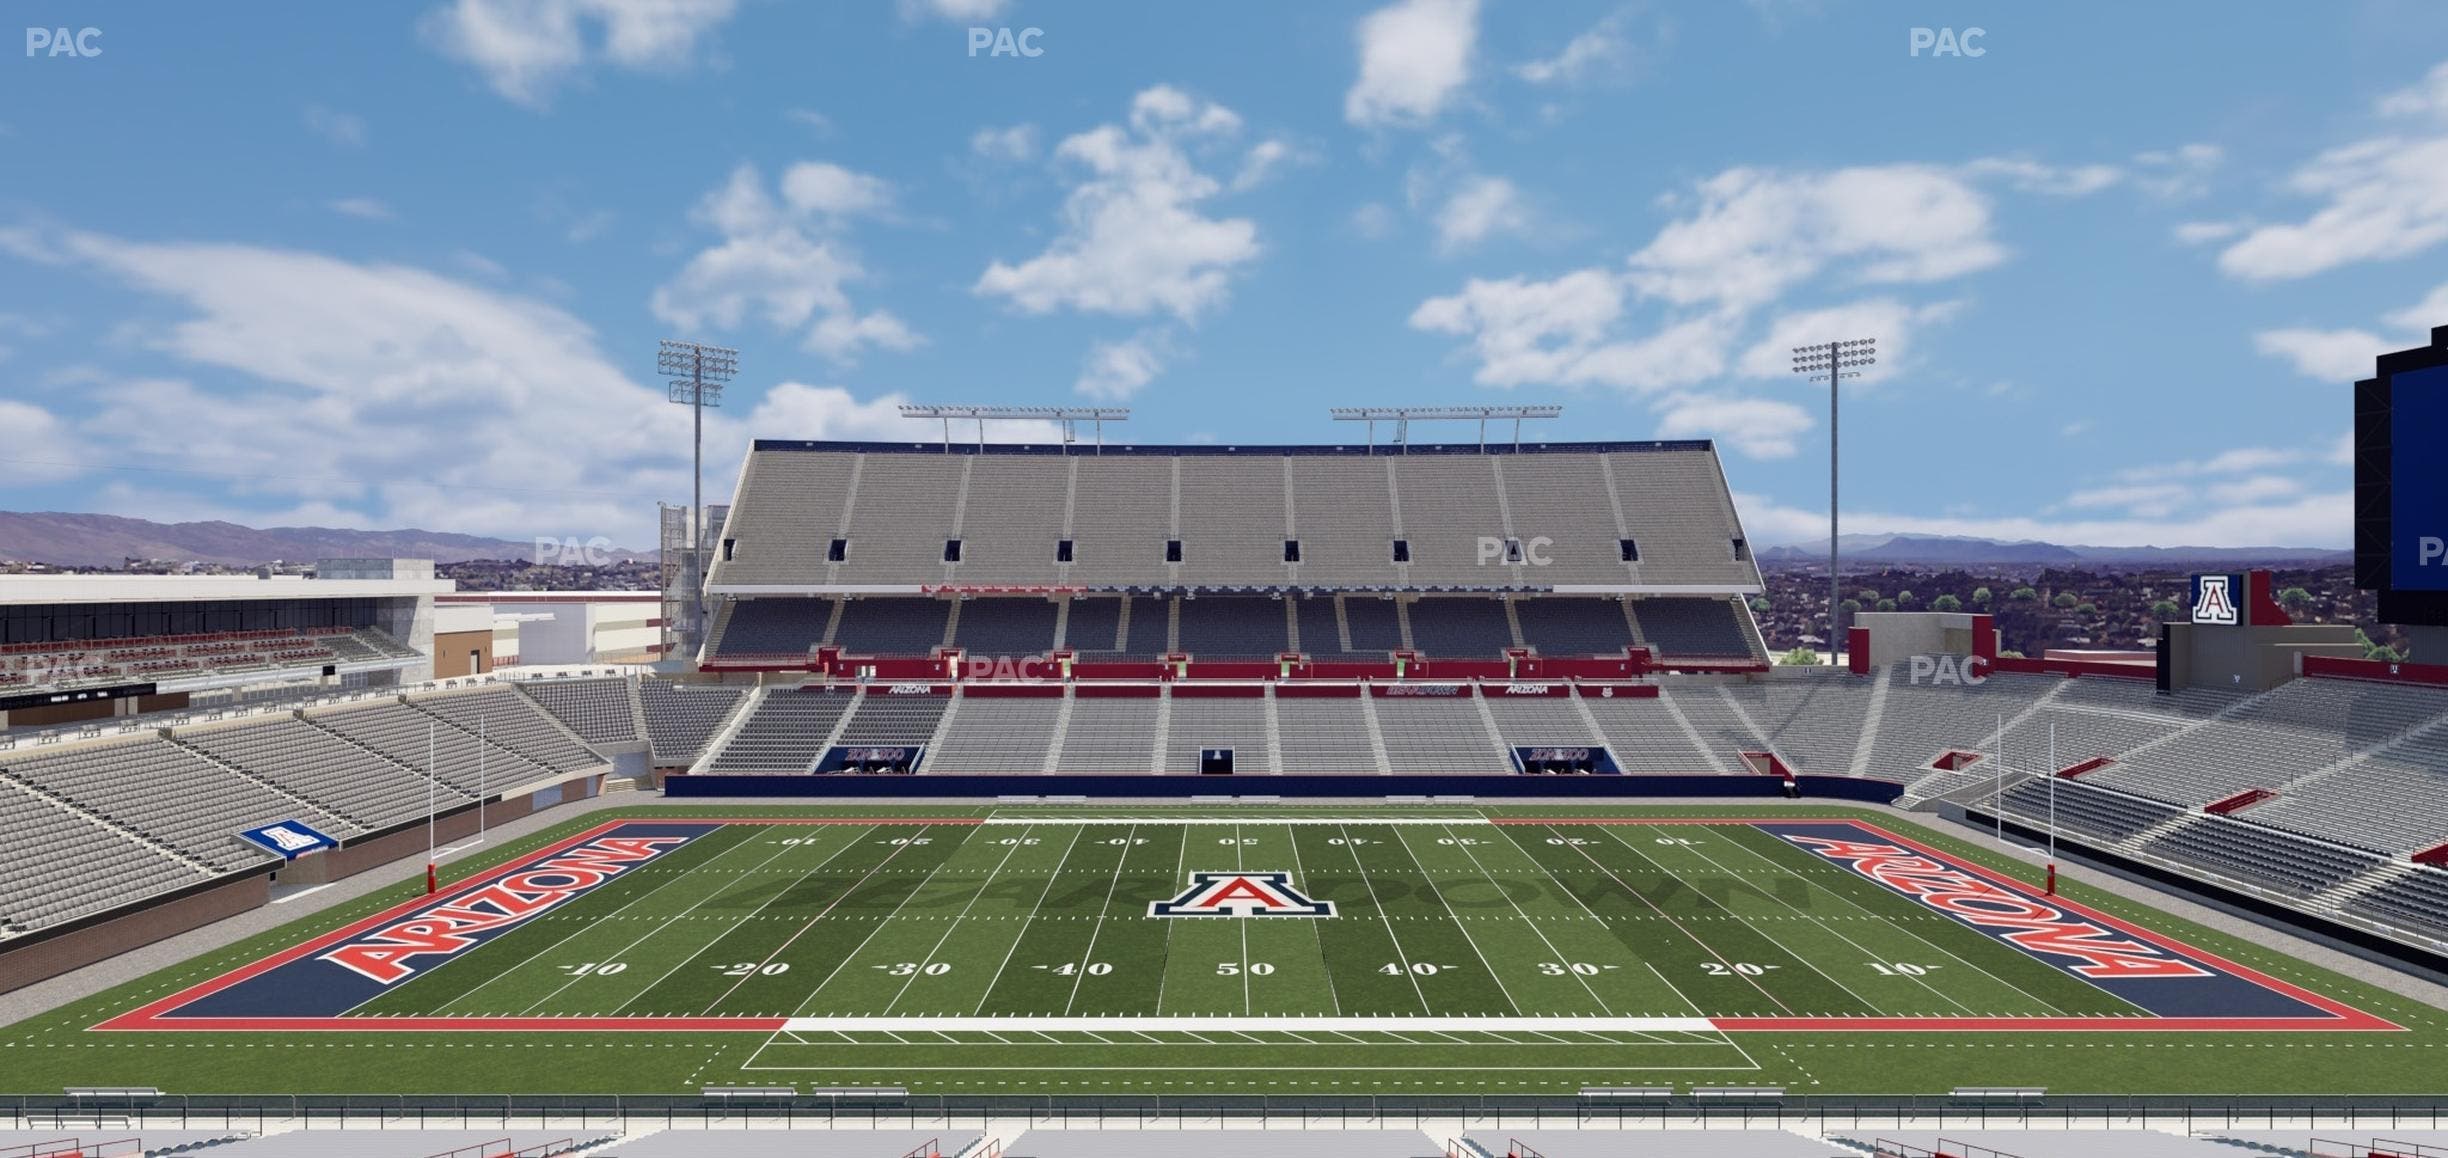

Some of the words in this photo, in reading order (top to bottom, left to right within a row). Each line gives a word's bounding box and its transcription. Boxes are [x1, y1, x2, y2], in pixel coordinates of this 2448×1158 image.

[2193, 576, 2237, 625] A
[888, 684, 931, 695] ARIZONA
[1506, 684, 1549, 695] ARIZONA
[1146, 871, 1339, 918] A
[315, 836, 688, 984] ARIZONA
[1782, 835, 2217, 978] ARIZONA
[564, 962, 628, 976] 10
[723, 962, 790, 976] 20
[887, 962, 952, 976] 30
[1051, 962, 1113, 976] 40
[1216, 962, 1275, 976] 50
[1378, 962, 1439, 976] 40
[1538, 962, 1599, 976] 30
[1700, 962, 1764, 976] 20
[1864, 962, 1928, 976] 10
